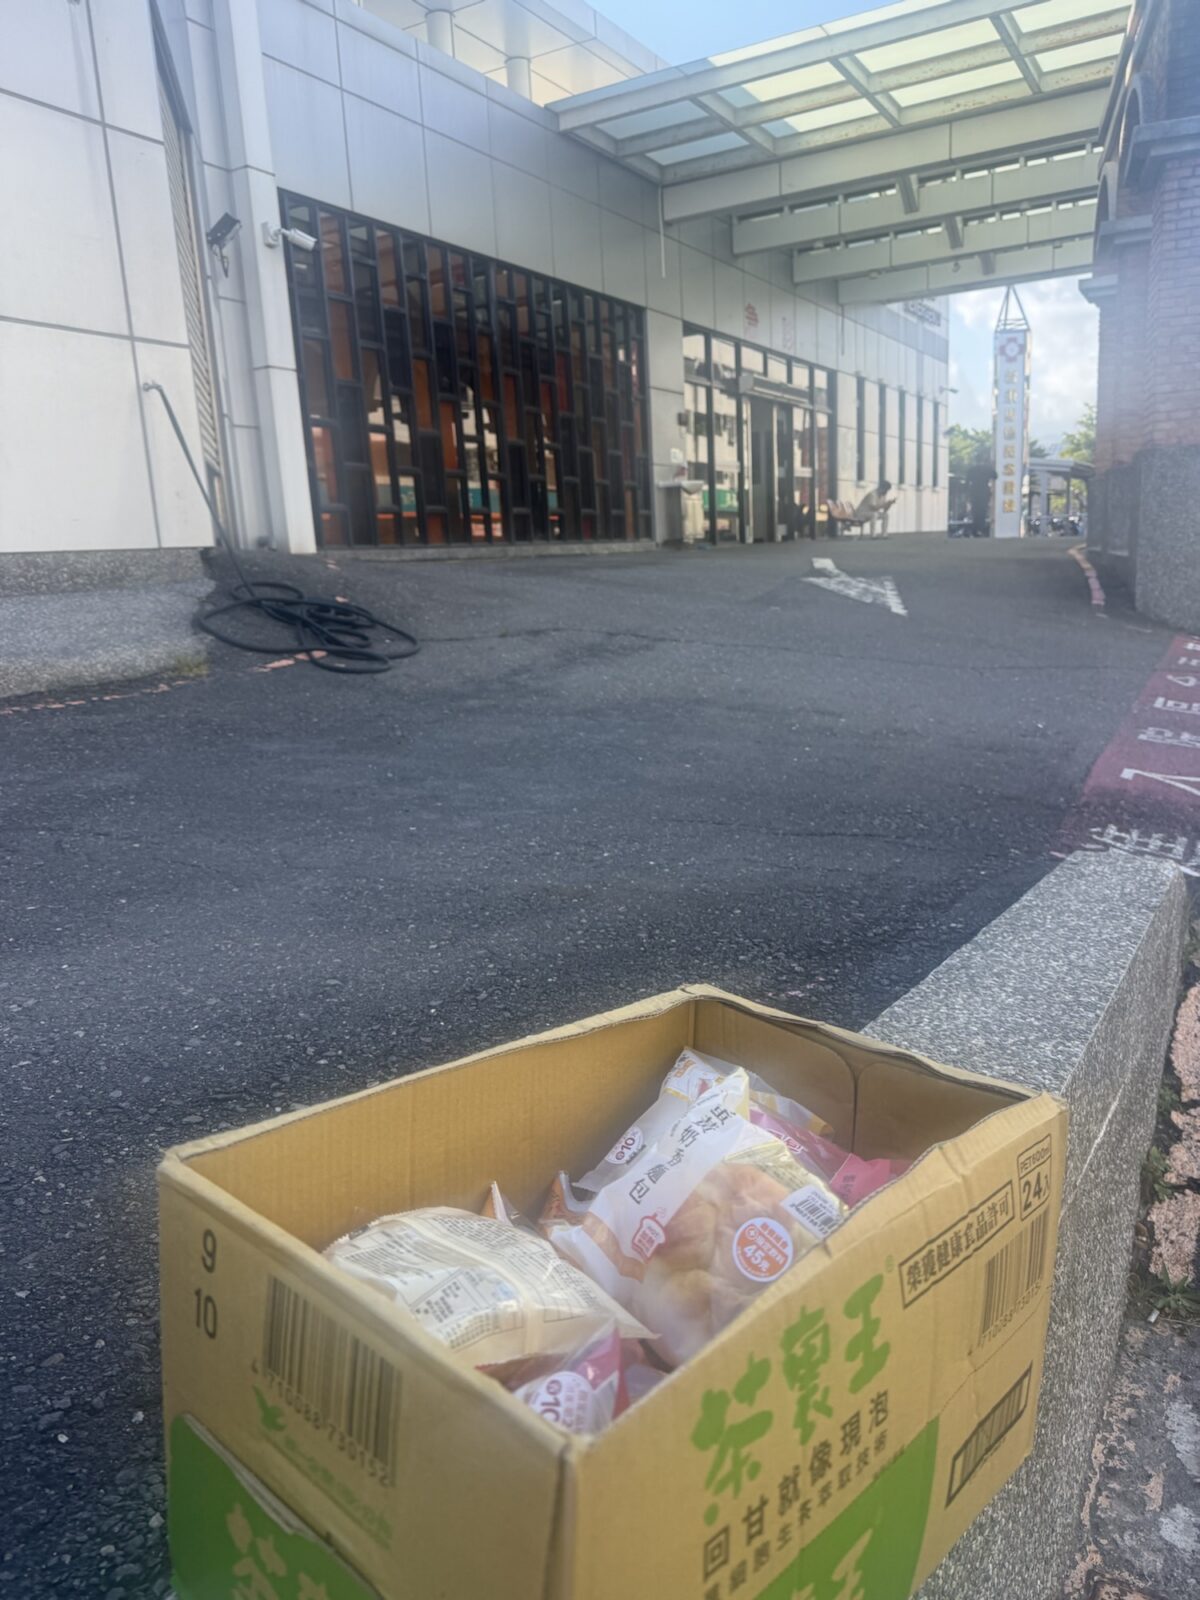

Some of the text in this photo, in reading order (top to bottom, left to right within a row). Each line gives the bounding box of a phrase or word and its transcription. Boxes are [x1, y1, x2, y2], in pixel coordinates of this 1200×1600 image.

[202, 1229, 217, 1273] 9
[906, 1191, 1010, 1295] 榮獲健康食品許可
[195, 1288, 218, 1340] 10
[704, 1389, 889, 1584] 回甘就像現泡
